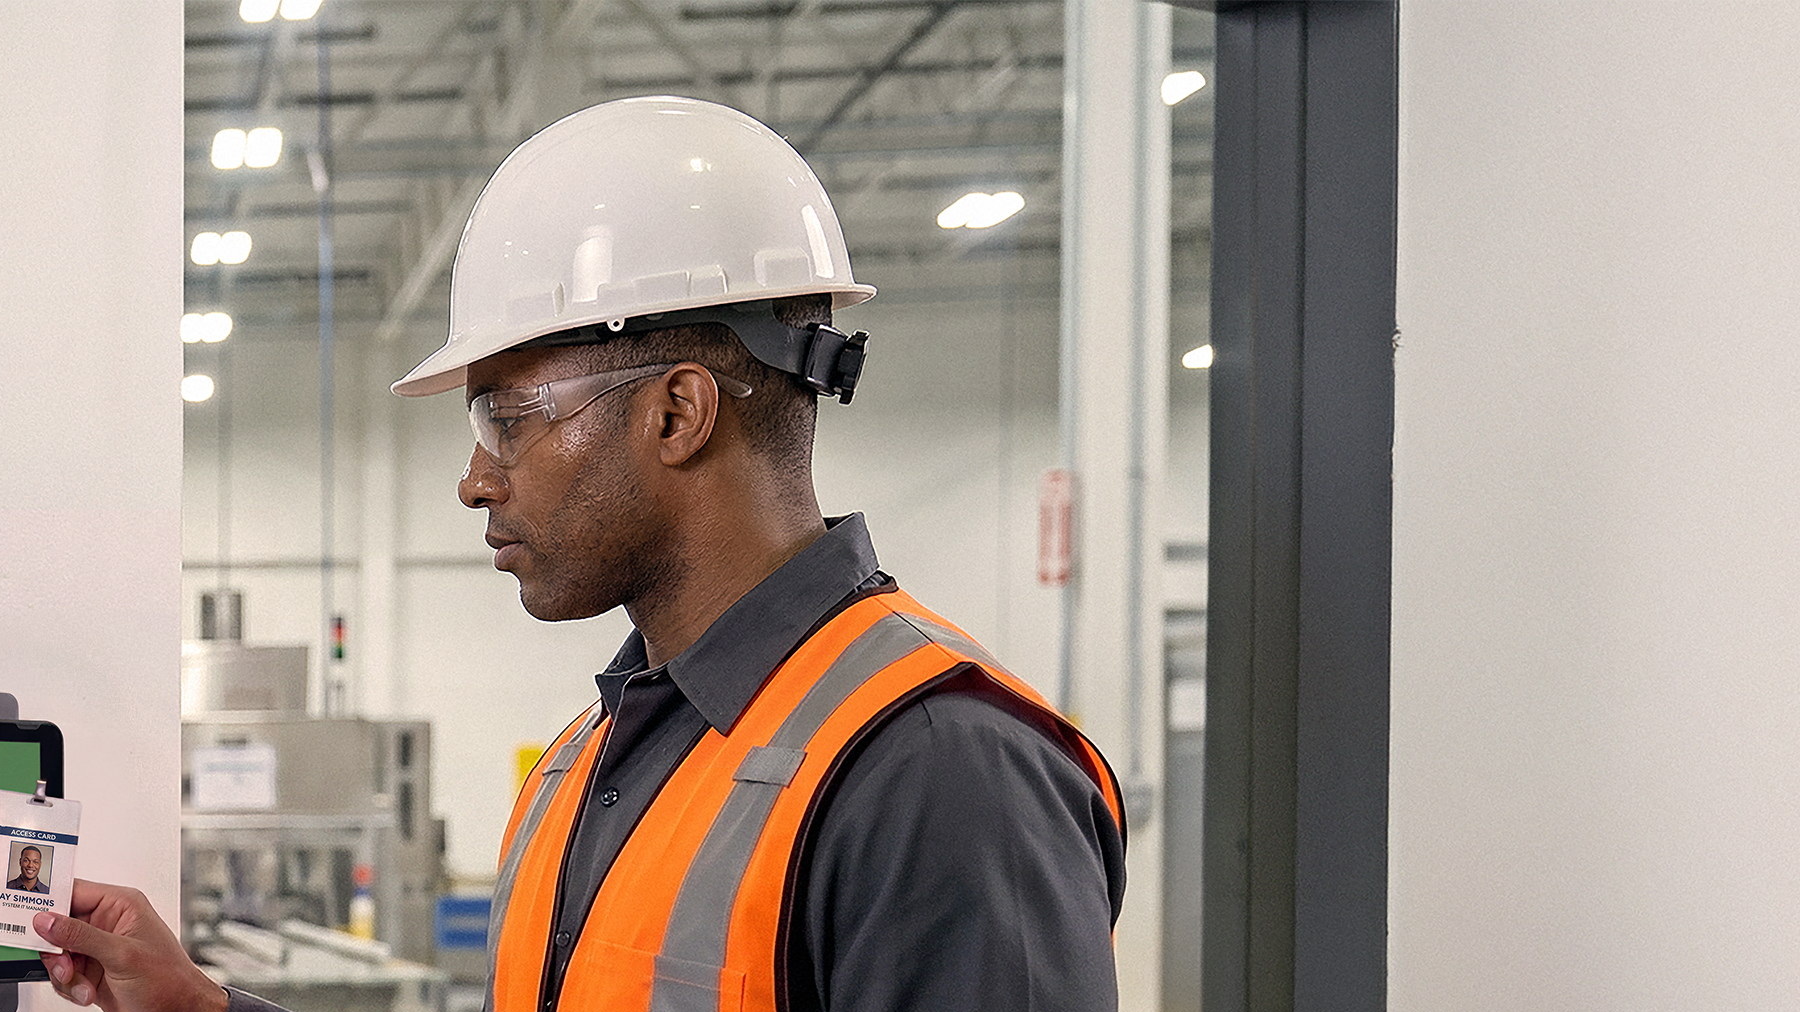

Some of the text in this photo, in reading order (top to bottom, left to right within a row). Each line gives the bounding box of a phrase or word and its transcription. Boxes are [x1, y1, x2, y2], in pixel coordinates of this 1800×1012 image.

[11, 829, 56, 841] ACCESS CARD
[13, 894, 55, 907] SIMMONS
